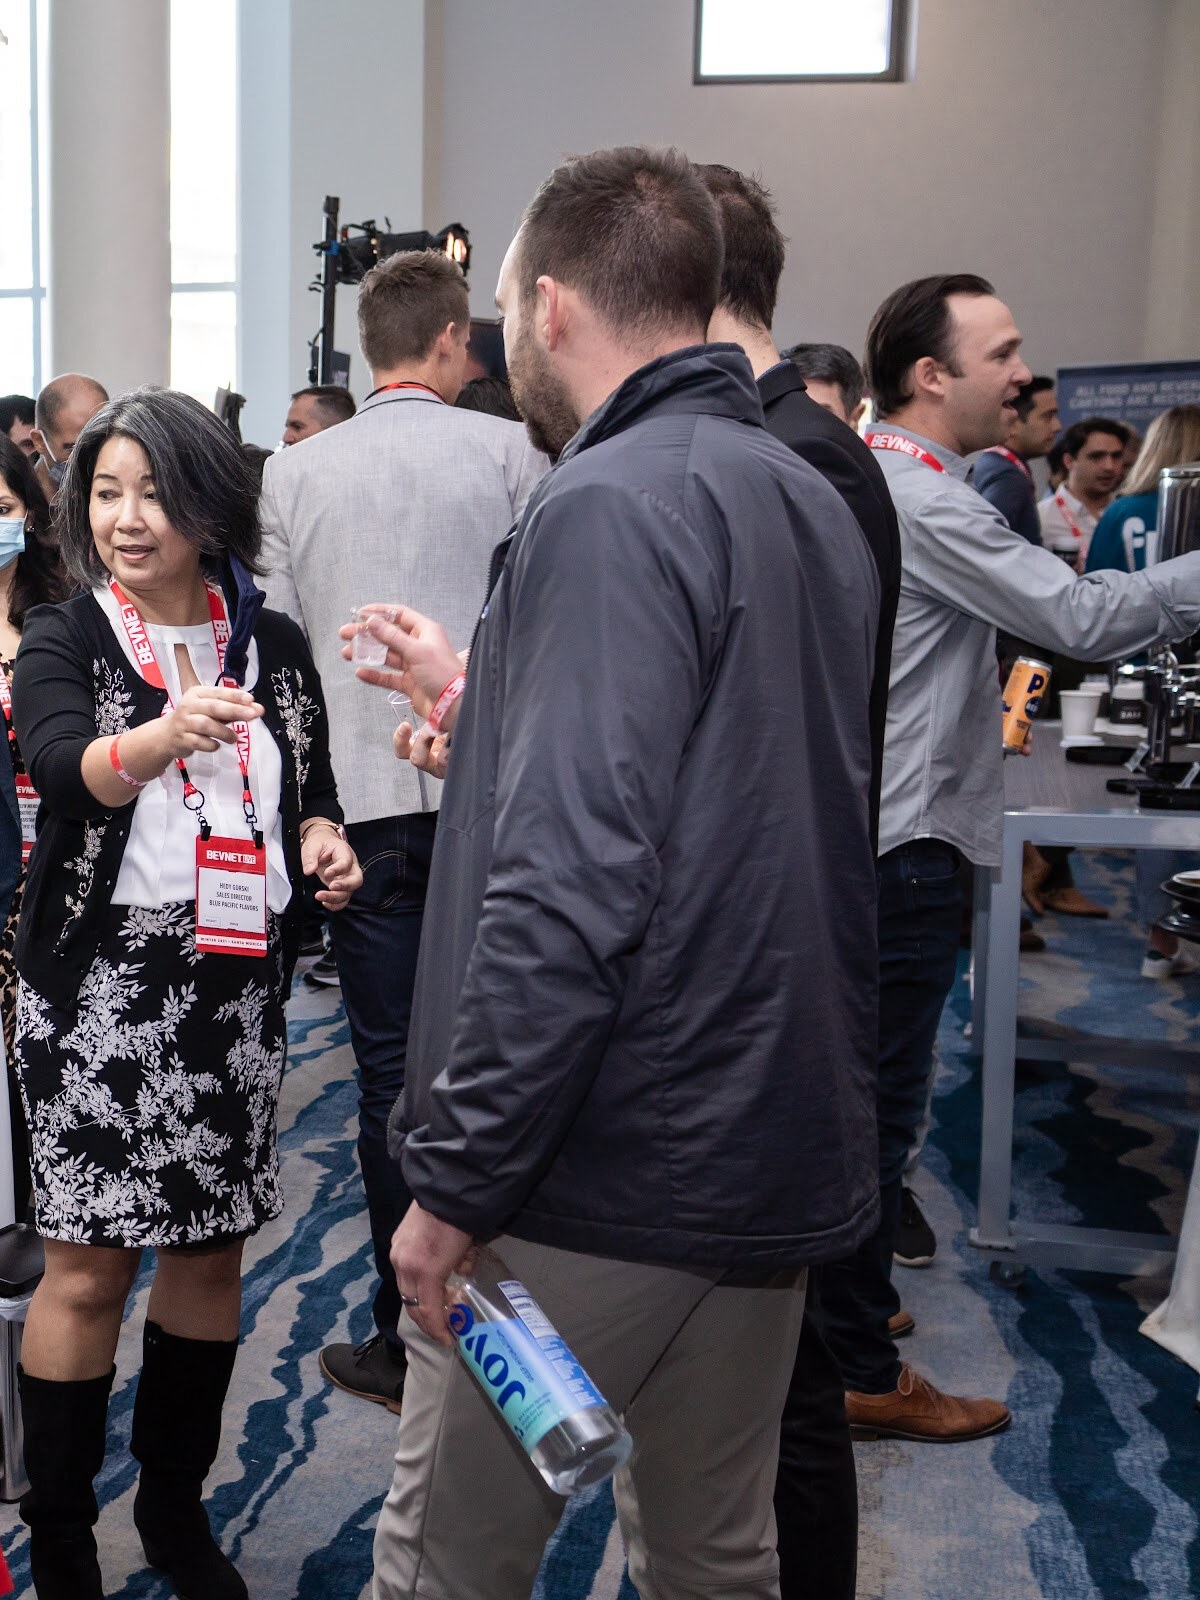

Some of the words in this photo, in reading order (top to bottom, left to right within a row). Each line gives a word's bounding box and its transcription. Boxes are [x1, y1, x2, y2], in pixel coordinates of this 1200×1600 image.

[871, 434, 927, 458] BEVNET
[121, 603, 155, 665] BEVNET
[206, 850, 243, 863] BEVNET
[232, 884, 250, 892] GORSKI
[216, 891, 230, 899] SALES
[230, 893, 252, 902] DIRECTOR
[209, 899, 221, 907] BLUE
[221, 901, 239, 909] PACIFIC
[239, 903, 259, 912] FLAVORS
